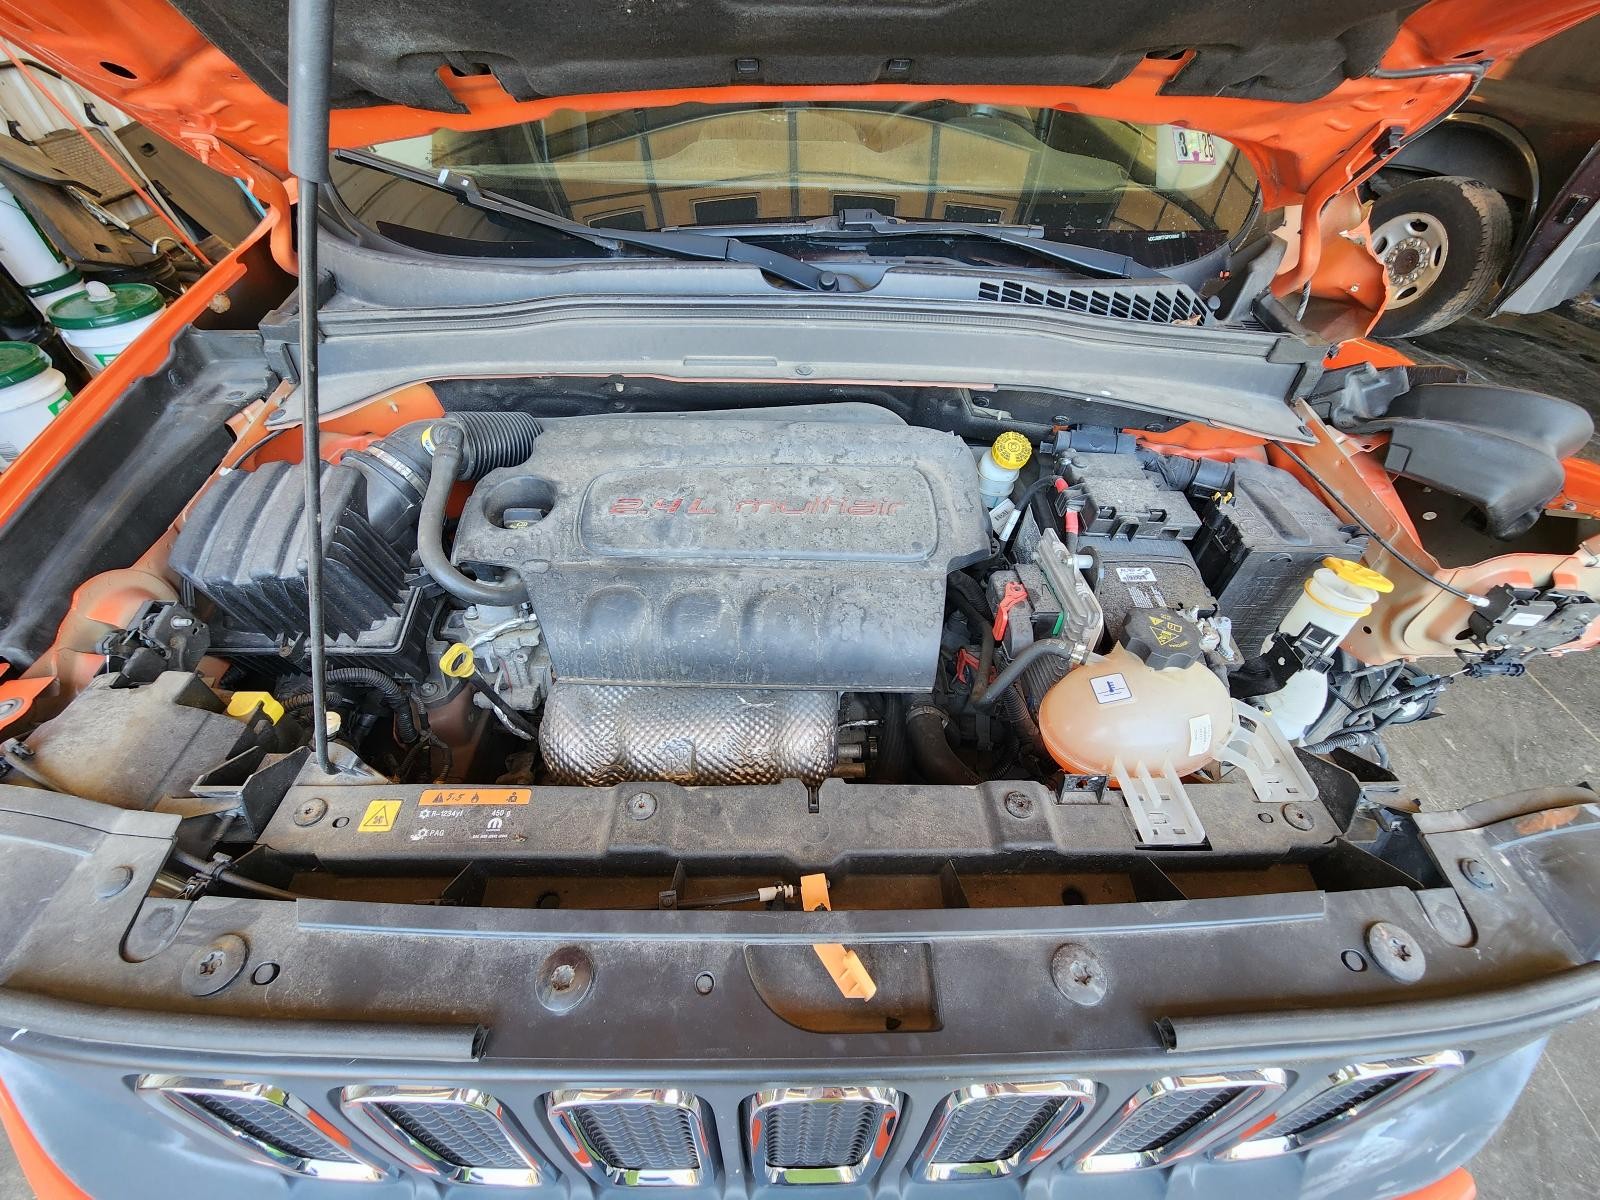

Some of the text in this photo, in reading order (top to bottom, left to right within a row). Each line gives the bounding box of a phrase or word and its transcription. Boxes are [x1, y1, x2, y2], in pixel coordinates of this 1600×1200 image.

[1179, 132, 1214, 158] 3 26
[608, 496, 905, 516] 2.4L multiair
[491, 809, 505, 817] 450
[429, 829, 445, 837] PAG
